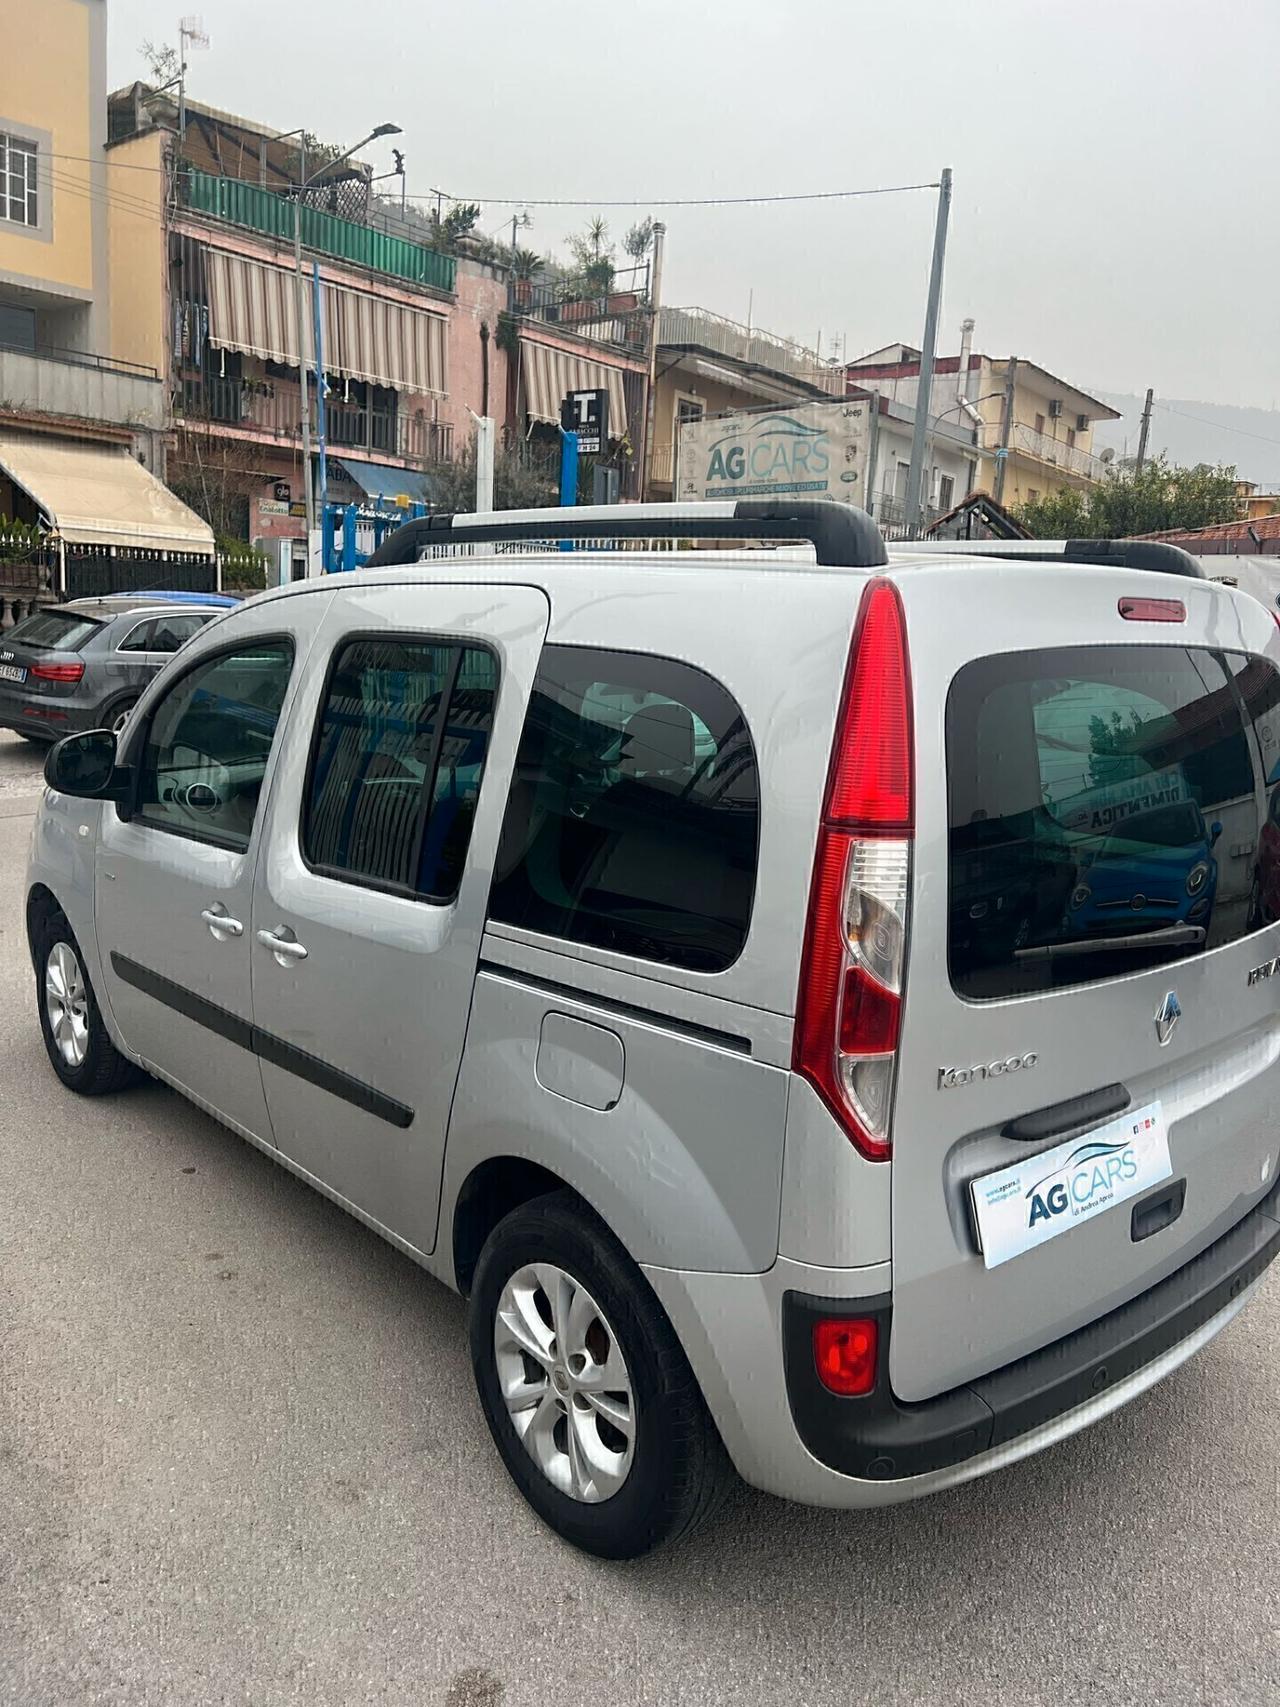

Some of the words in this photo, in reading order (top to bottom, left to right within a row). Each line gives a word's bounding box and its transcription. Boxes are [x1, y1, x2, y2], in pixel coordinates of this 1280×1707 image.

[843, 408, 862, 418] Jeep
[705, 446, 746, 481] AG
[750, 437, 831, 478] CARS
[1028, 1183, 1069, 1228] AG
[1071, 1149, 1138, 1204] CARS
[1080, 1199, 1099, 1214] Andrea
